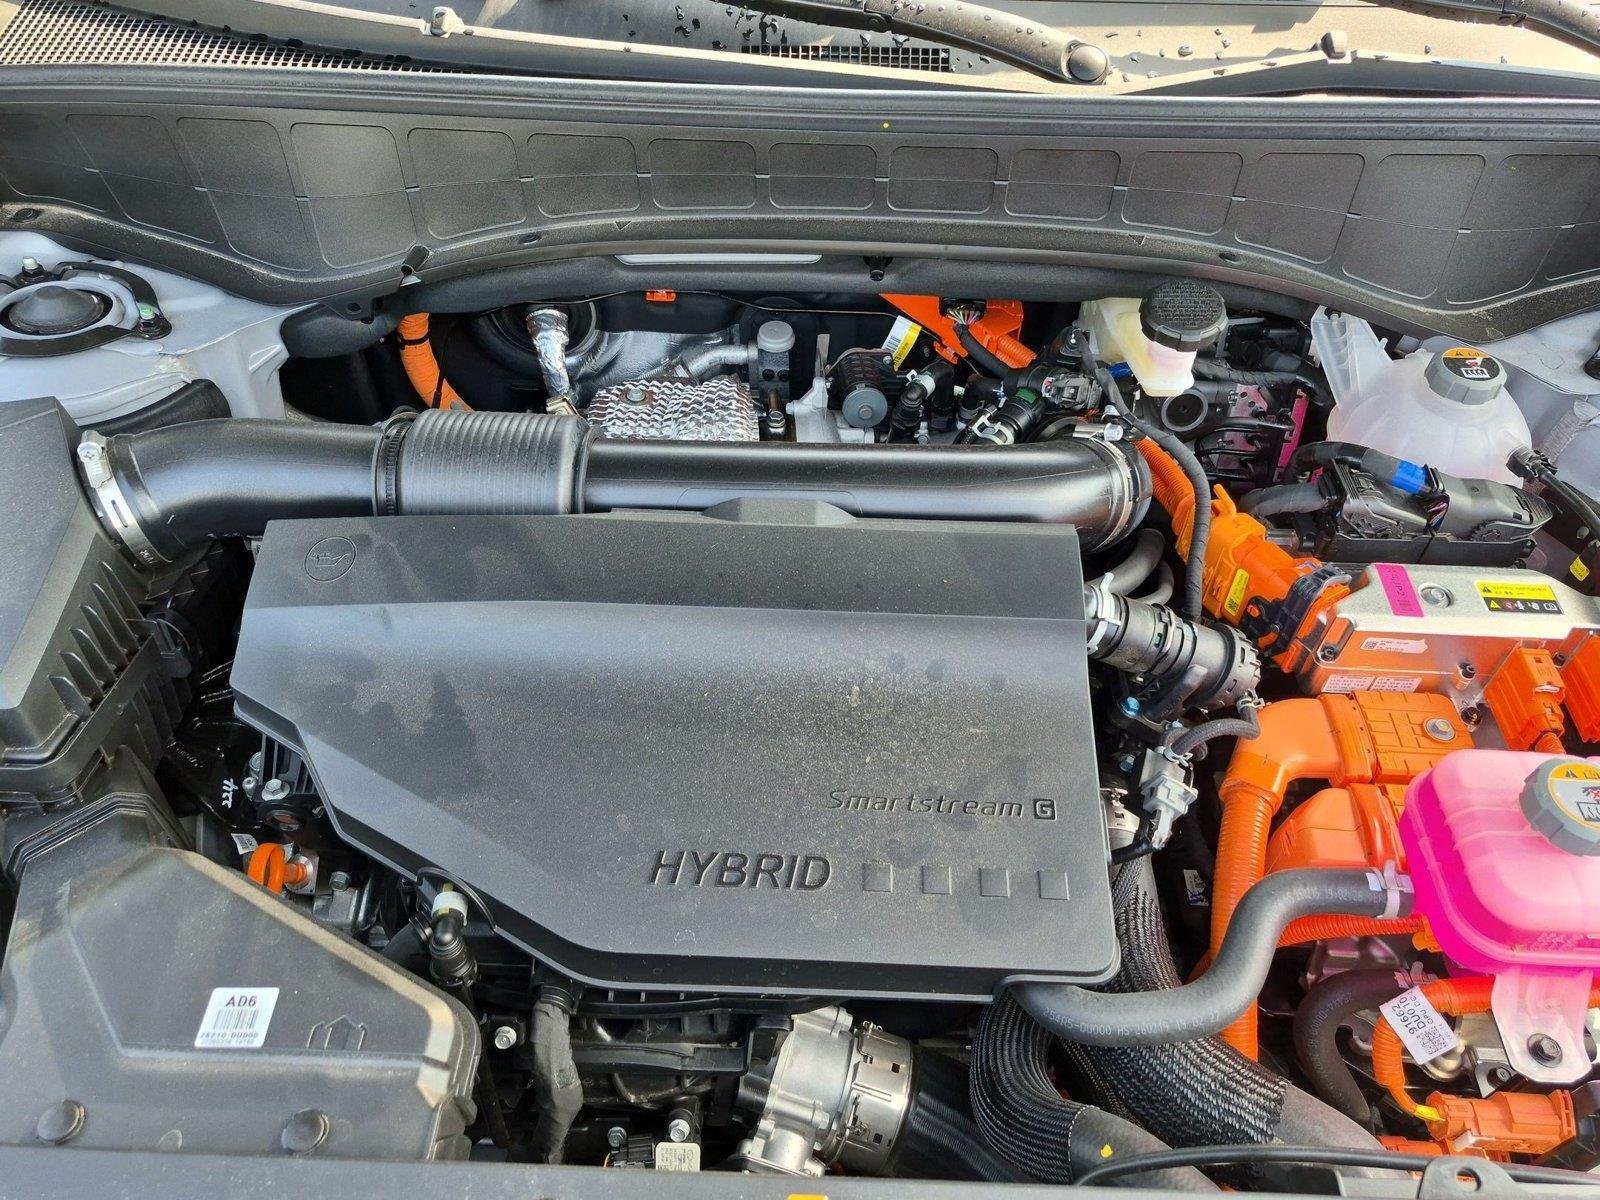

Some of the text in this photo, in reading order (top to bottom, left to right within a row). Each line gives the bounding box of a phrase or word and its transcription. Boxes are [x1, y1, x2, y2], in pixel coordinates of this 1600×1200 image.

[826, 790, 1057, 821] Smartstream G
[649, 850, 832, 891] HYBRID
[225, 995, 258, 1007] AD6
[1399, 996, 1427, 1030] DU010
[1392, 1003, 1417, 1035] 91662
